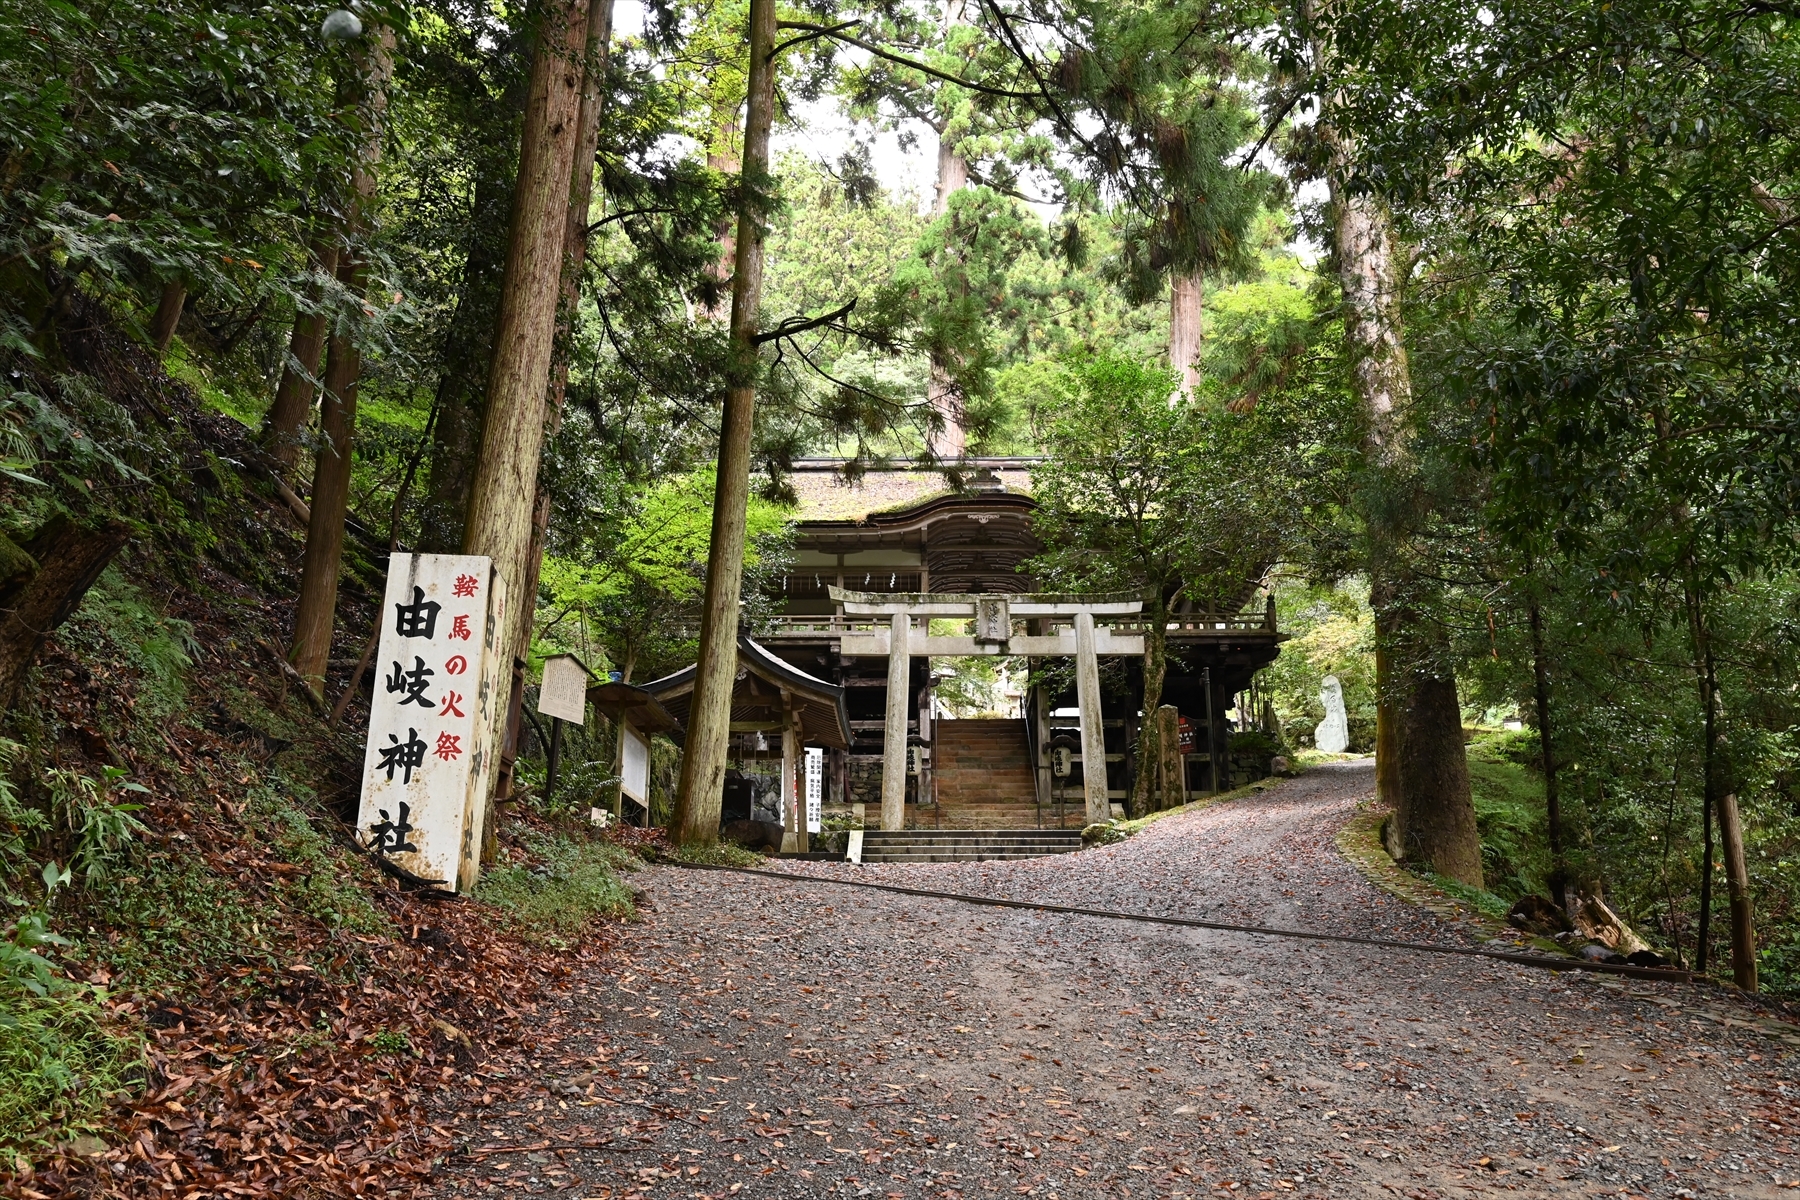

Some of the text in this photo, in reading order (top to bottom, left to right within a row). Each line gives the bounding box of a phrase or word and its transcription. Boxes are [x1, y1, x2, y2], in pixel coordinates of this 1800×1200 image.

[367, 585, 442, 854] 由岐神社
[432, 574, 479, 762] 鞍馬の火祭
